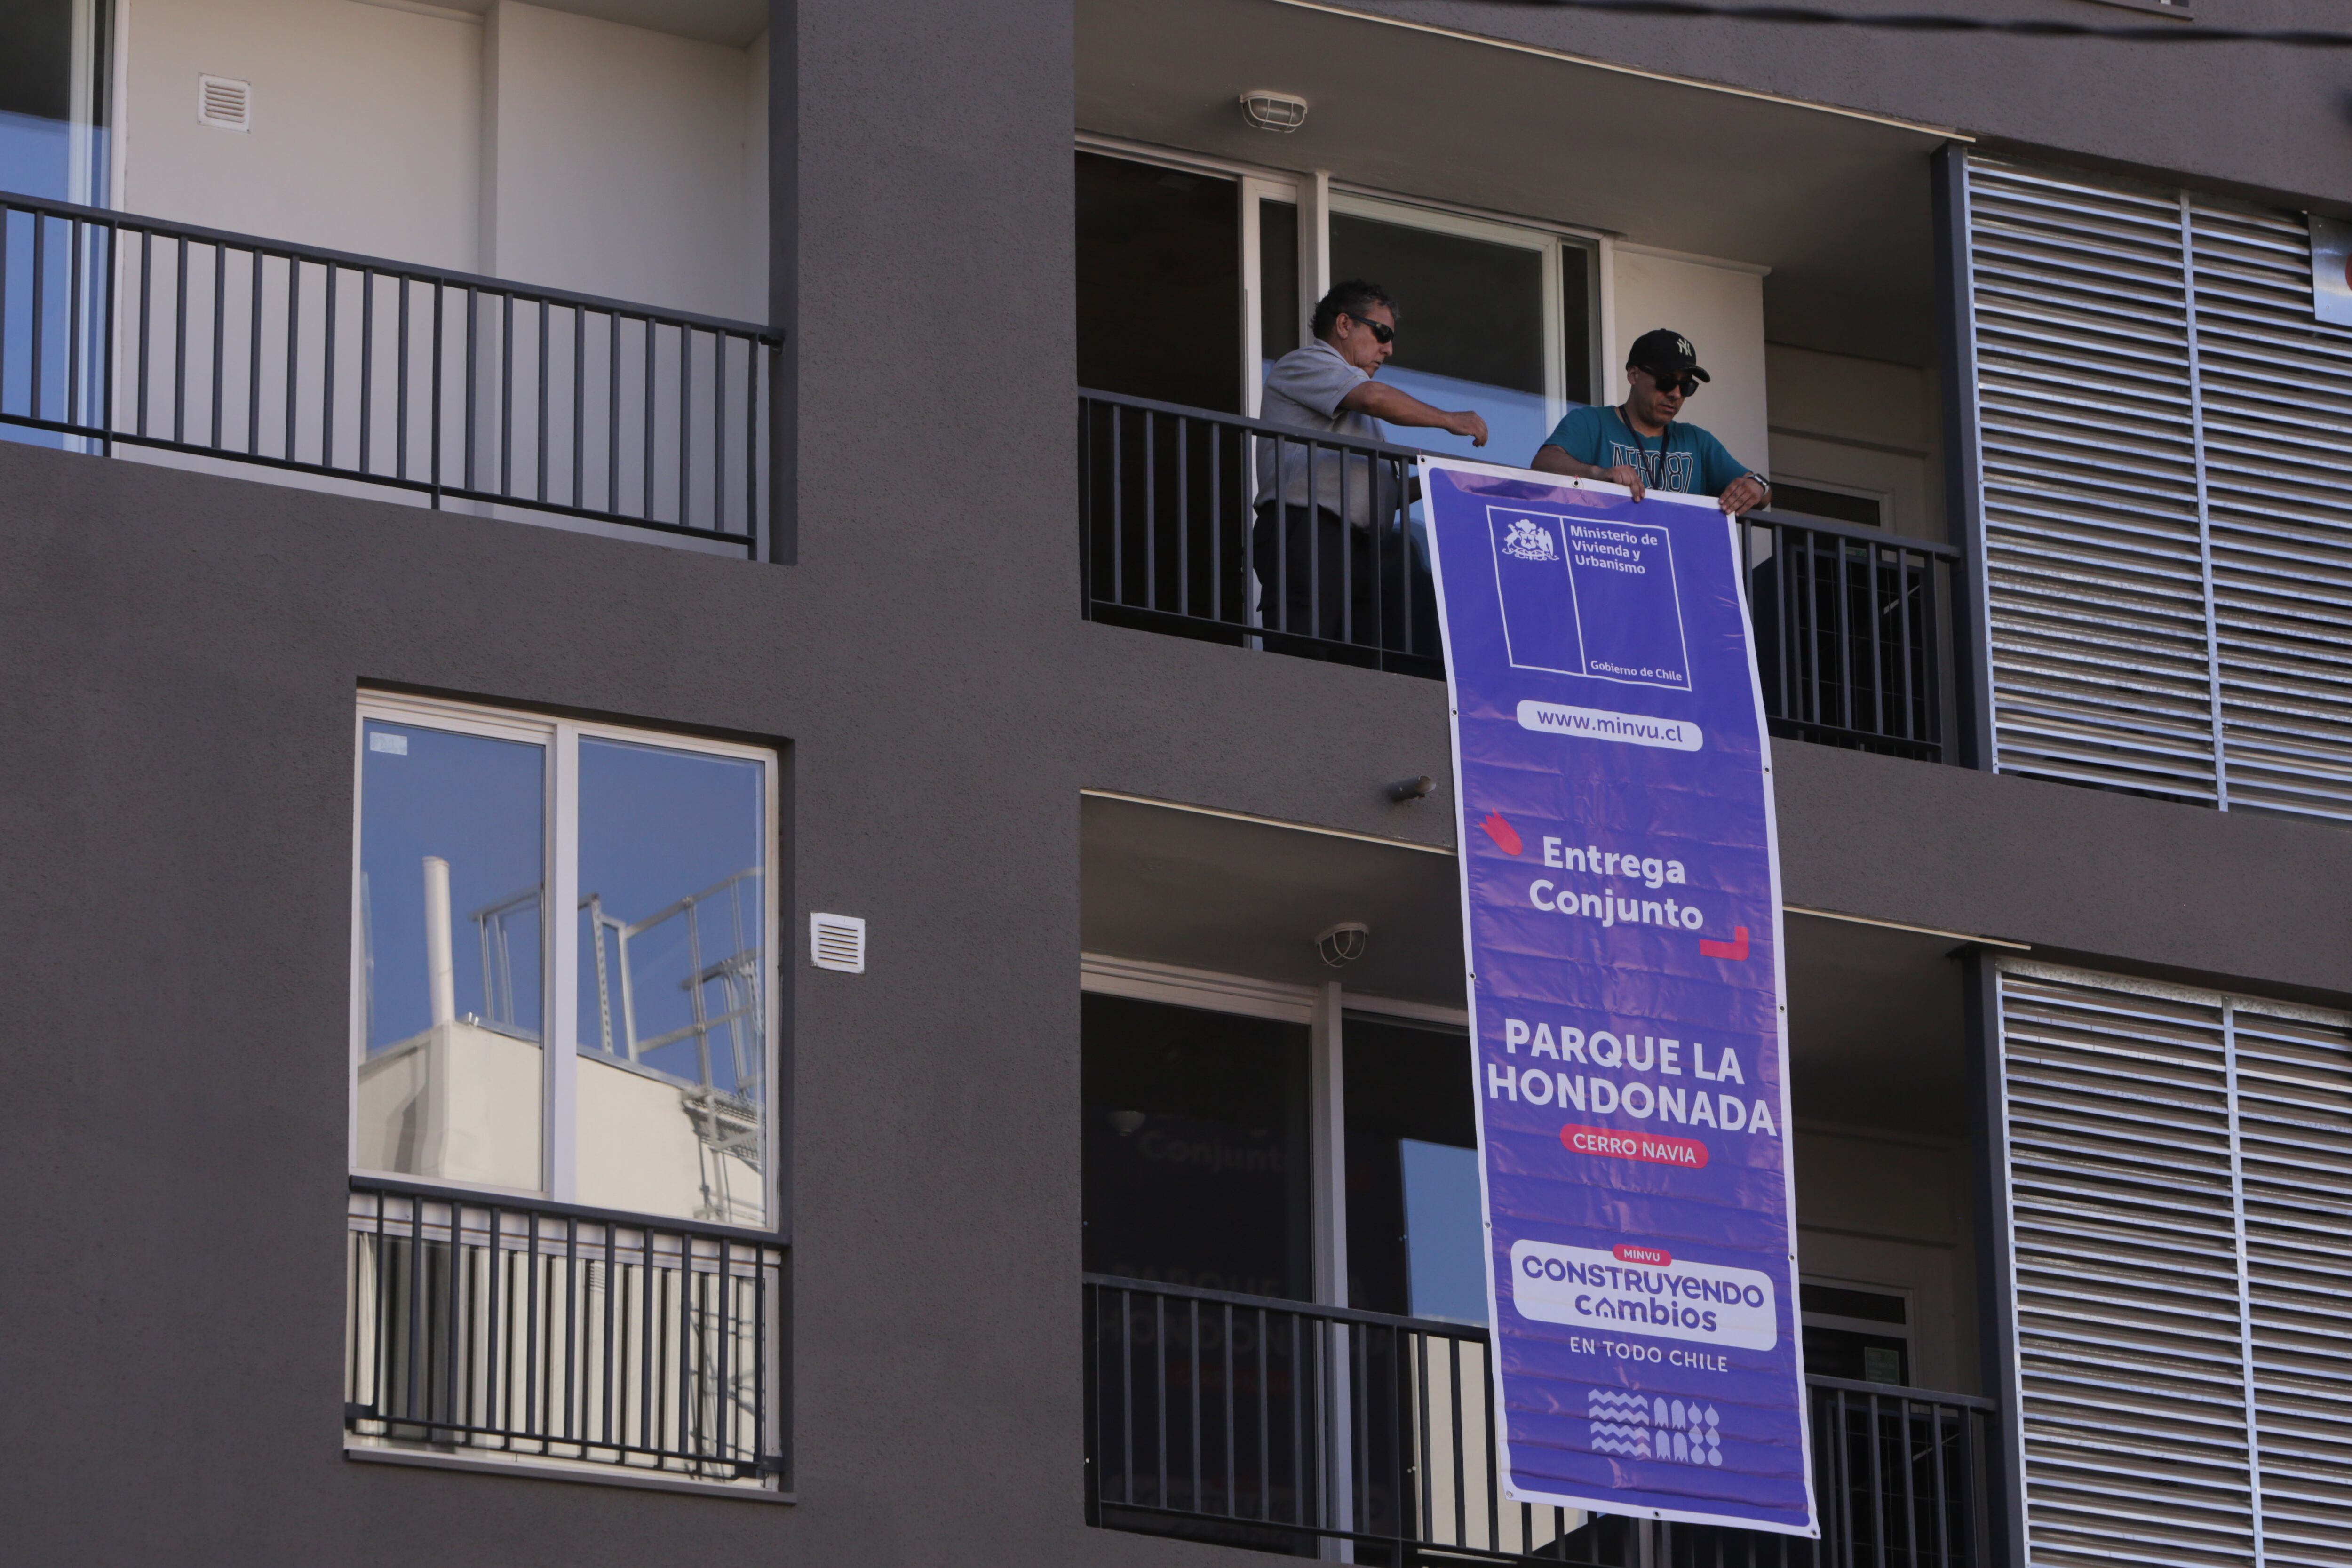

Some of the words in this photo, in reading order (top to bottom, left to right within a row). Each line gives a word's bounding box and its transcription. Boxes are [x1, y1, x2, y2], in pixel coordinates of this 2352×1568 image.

[1571, 525, 1637, 544] Ministerio
[1641, 534, 1657, 545] de
[1572, 540, 1629, 557] Vivienda
[1633, 550, 1640, 561] y
[1575, 555, 1645, 573] Urbanismo
[1591, 661, 1637, 675] Gobierno
[1640, 668, 1653, 677] de
[1656, 669, 1682, 680] Chile
[1537, 711, 1682, 742] www.minvu.cl
[1543, 836, 1685, 888] Entrega
[1530, 880, 1703, 929] Conjunto
[1506, 1019, 1681, 1075] PARQUE
[1694, 1043, 1744, 1084] LA
[1488, 1064, 1777, 1136] HONDONADA
[1140, 1131, 1285, 1172] Conjunt
[1573, 1133, 1636, 1155] CERRO
[1643, 1142, 1696, 1163] NAVIA
[1624, 1249, 1660, 1261] MINVU
[1571, 1337, 1595, 1354] EN
[1603, 1341, 1661, 1362] TODO
[1669, 1350, 1727, 1372] CHILE
